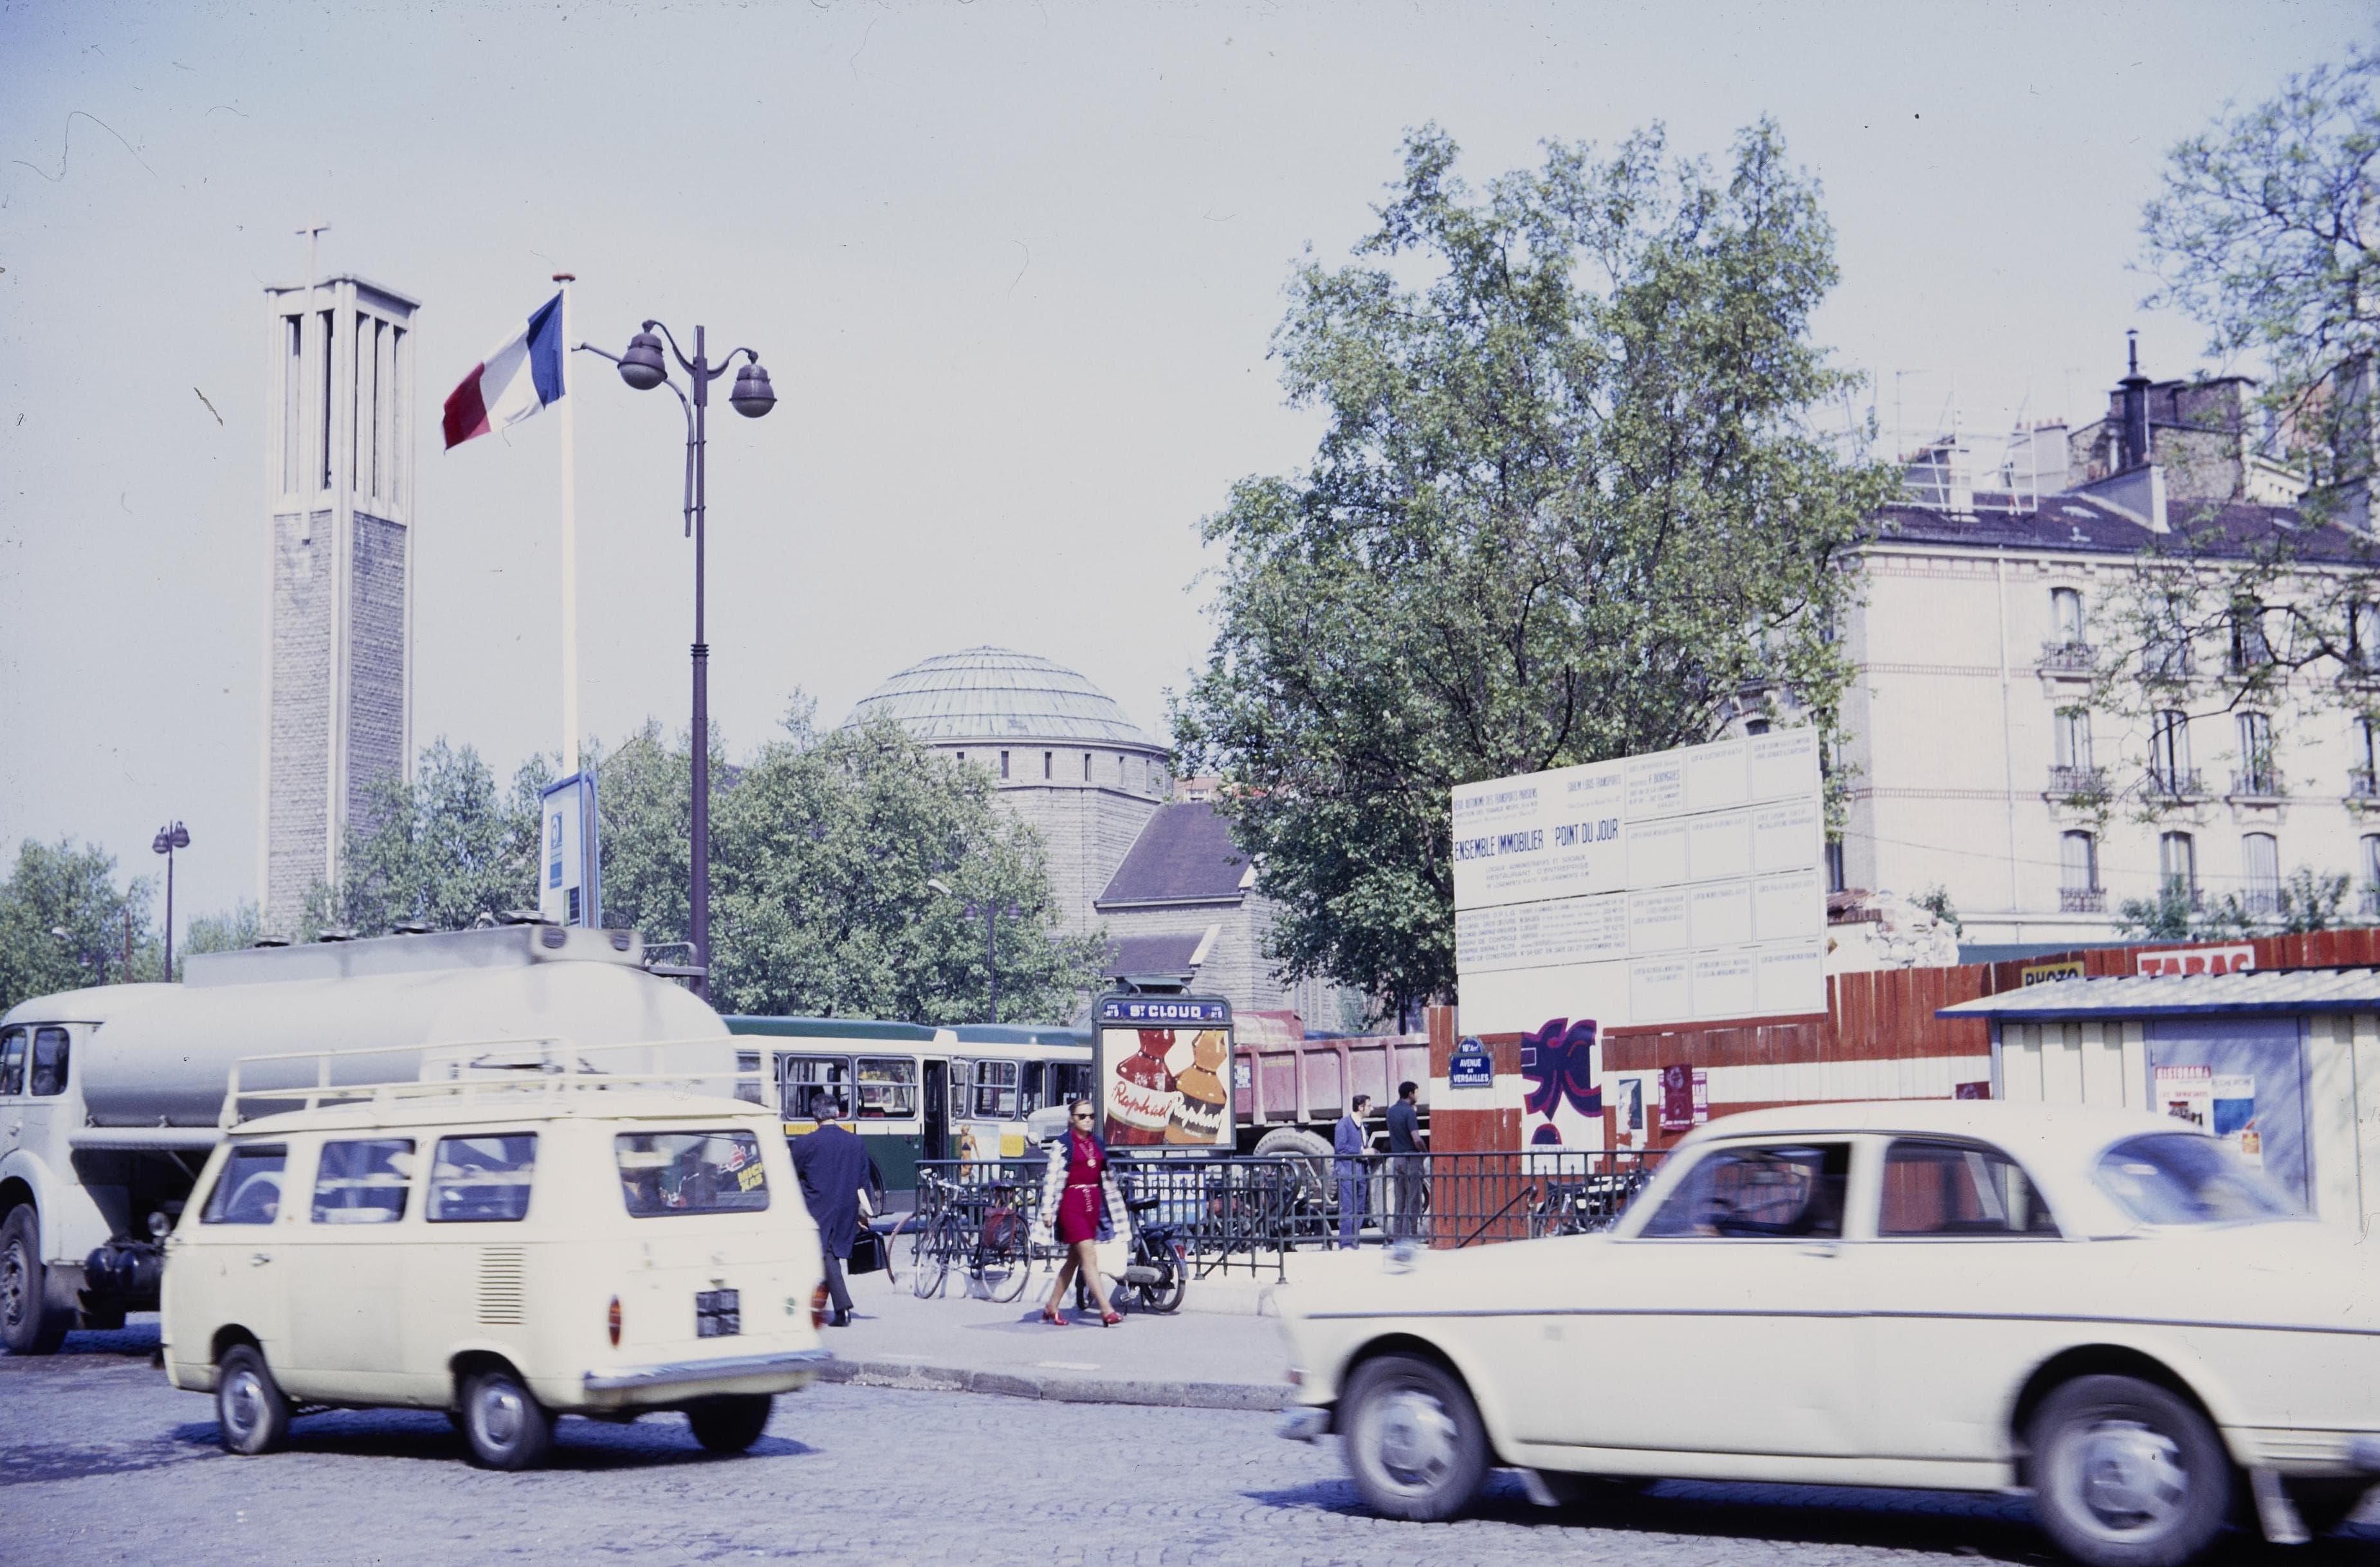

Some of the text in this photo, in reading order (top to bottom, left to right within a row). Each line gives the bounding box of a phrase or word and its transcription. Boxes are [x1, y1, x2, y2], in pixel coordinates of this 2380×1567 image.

[1454, 836, 1496, 862] ENSEMBLE
[1497, 829, 1544, 856] IMMOBILIER
[1582, 821, 1593, 844] DU
[1485, 870, 1531, 881] RESTAURANT
[2140, 953, 2249, 976] TABAC
[2025, 968, 2078, 986] PHOTO
[1148, 1005, 1202, 1018] CLOUD
[1460, 1058, 1481, 1067] AVENUE
[1453, 1074, 1489, 1083] VERSAILLES
